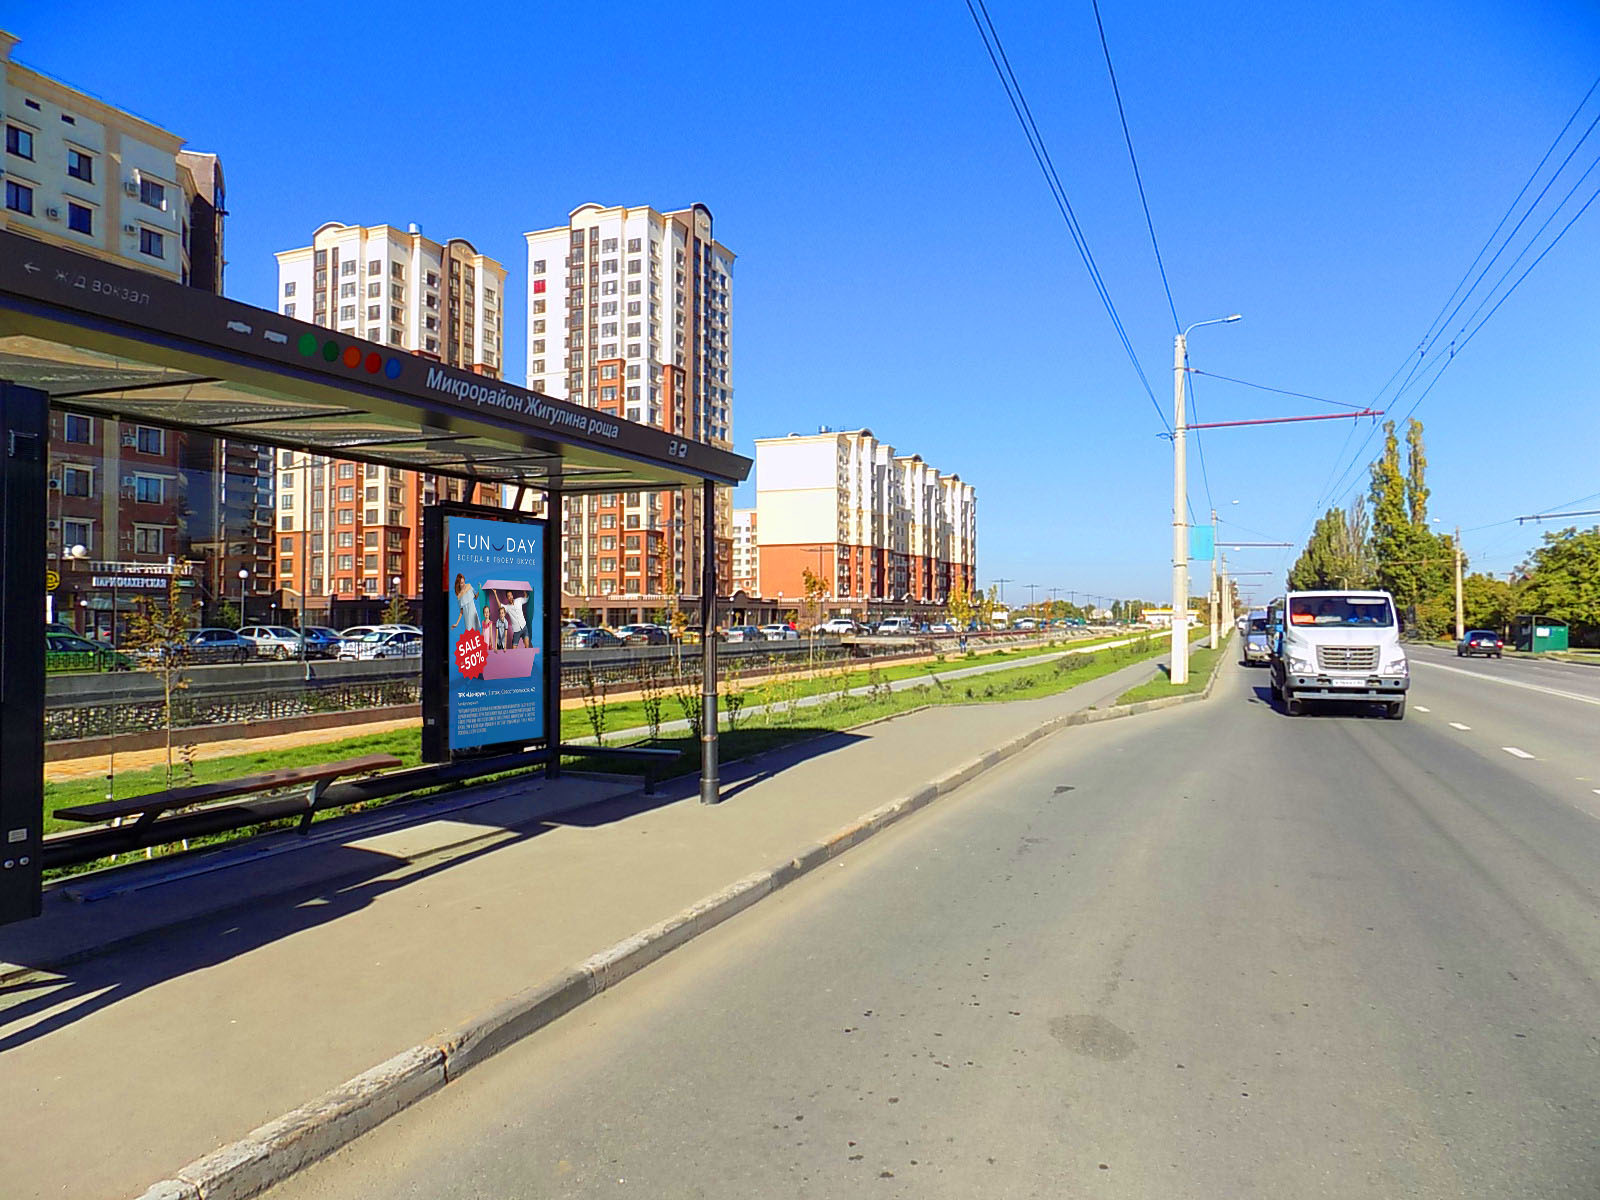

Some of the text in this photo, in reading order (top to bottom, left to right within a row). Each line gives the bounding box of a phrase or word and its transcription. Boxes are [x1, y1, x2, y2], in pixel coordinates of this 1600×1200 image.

[92, 279, 150, 304] вокзал
[426, 367, 620, 438] Микрорайон Жигулина роща
[457, 533, 536, 554] FUN DAY
[92, 576, 167, 588] ПАРИКМАХЕРСКАЯ
[458, 635, 481, 656] SALE
[460, 650, 485, 670] -50%
